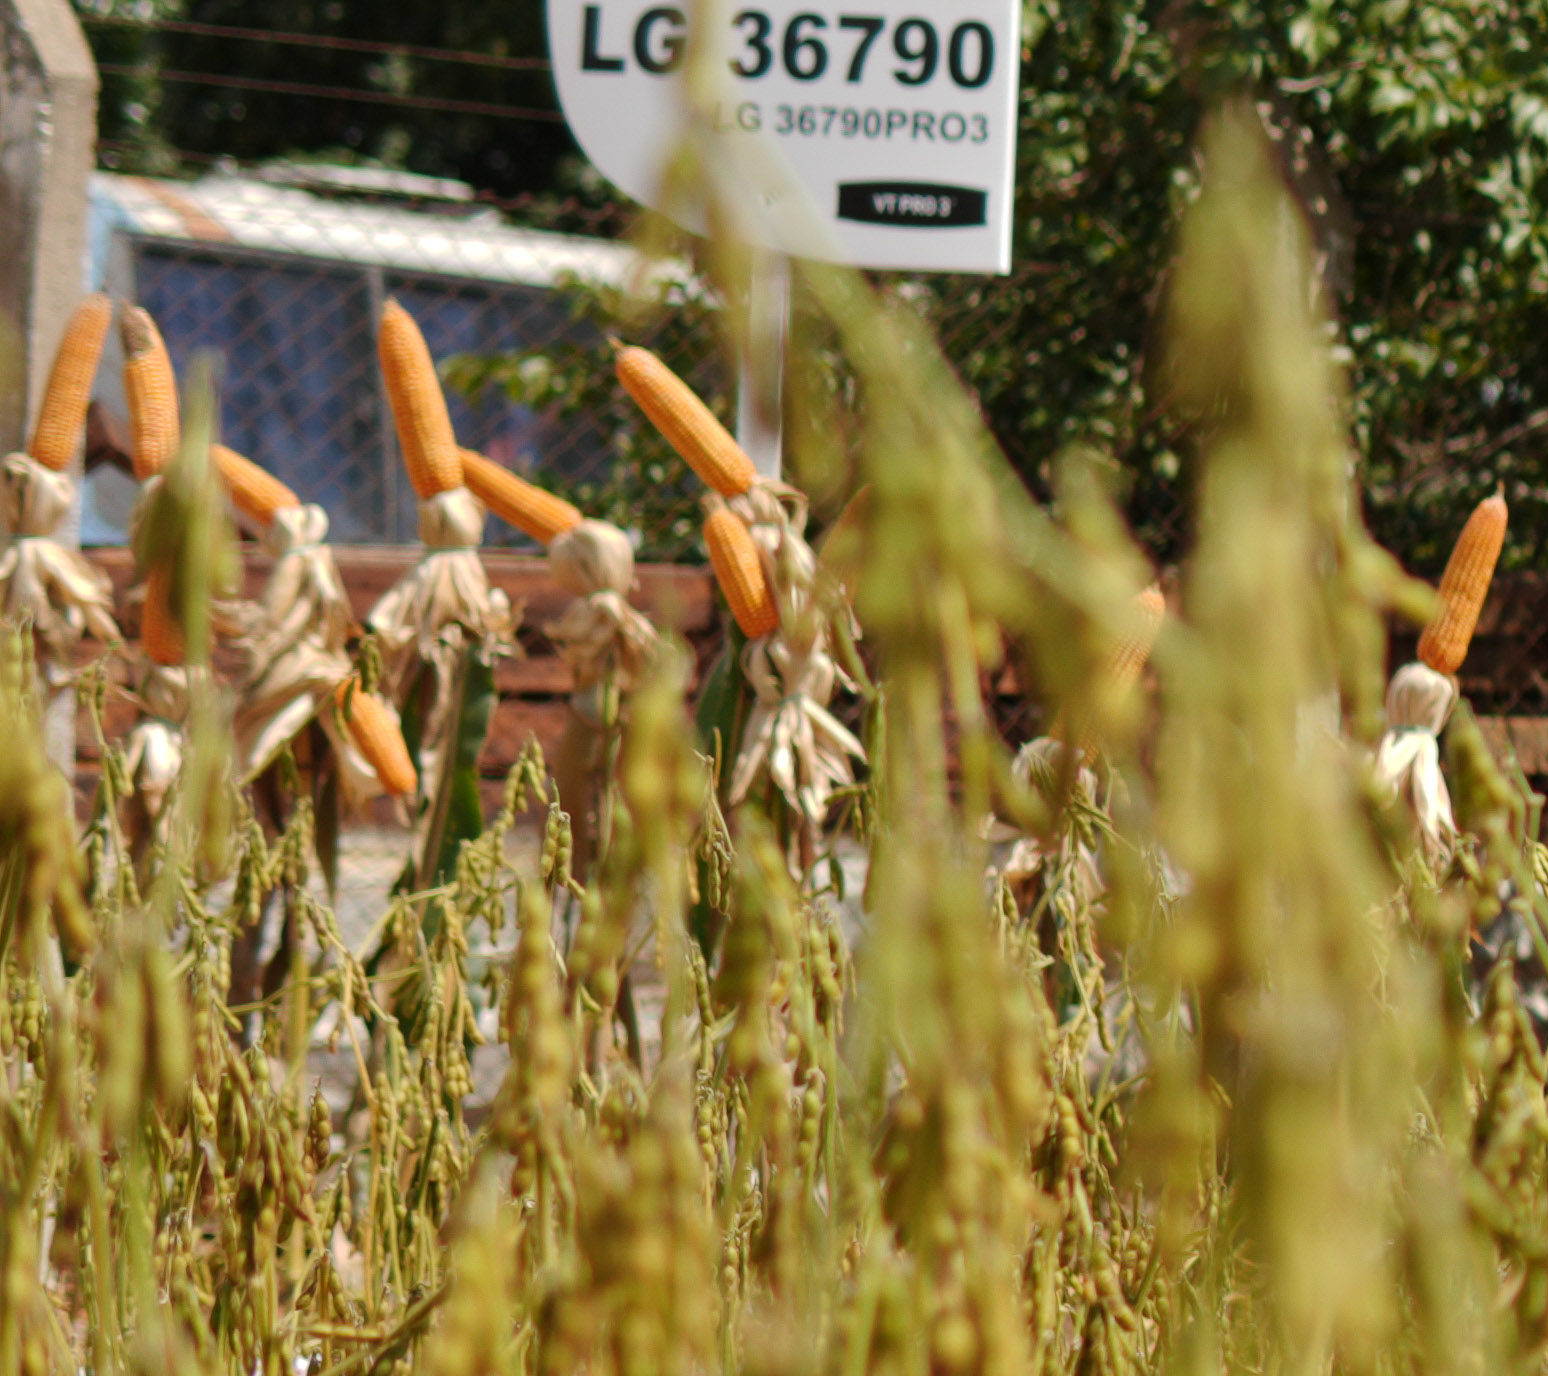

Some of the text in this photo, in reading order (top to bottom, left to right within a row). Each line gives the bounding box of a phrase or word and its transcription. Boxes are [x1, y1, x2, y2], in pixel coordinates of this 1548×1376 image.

[581, 4, 996, 89] LG 36790
[775, 107, 988, 143] 36790PRO3
[898, 193, 937, 218] PRO
